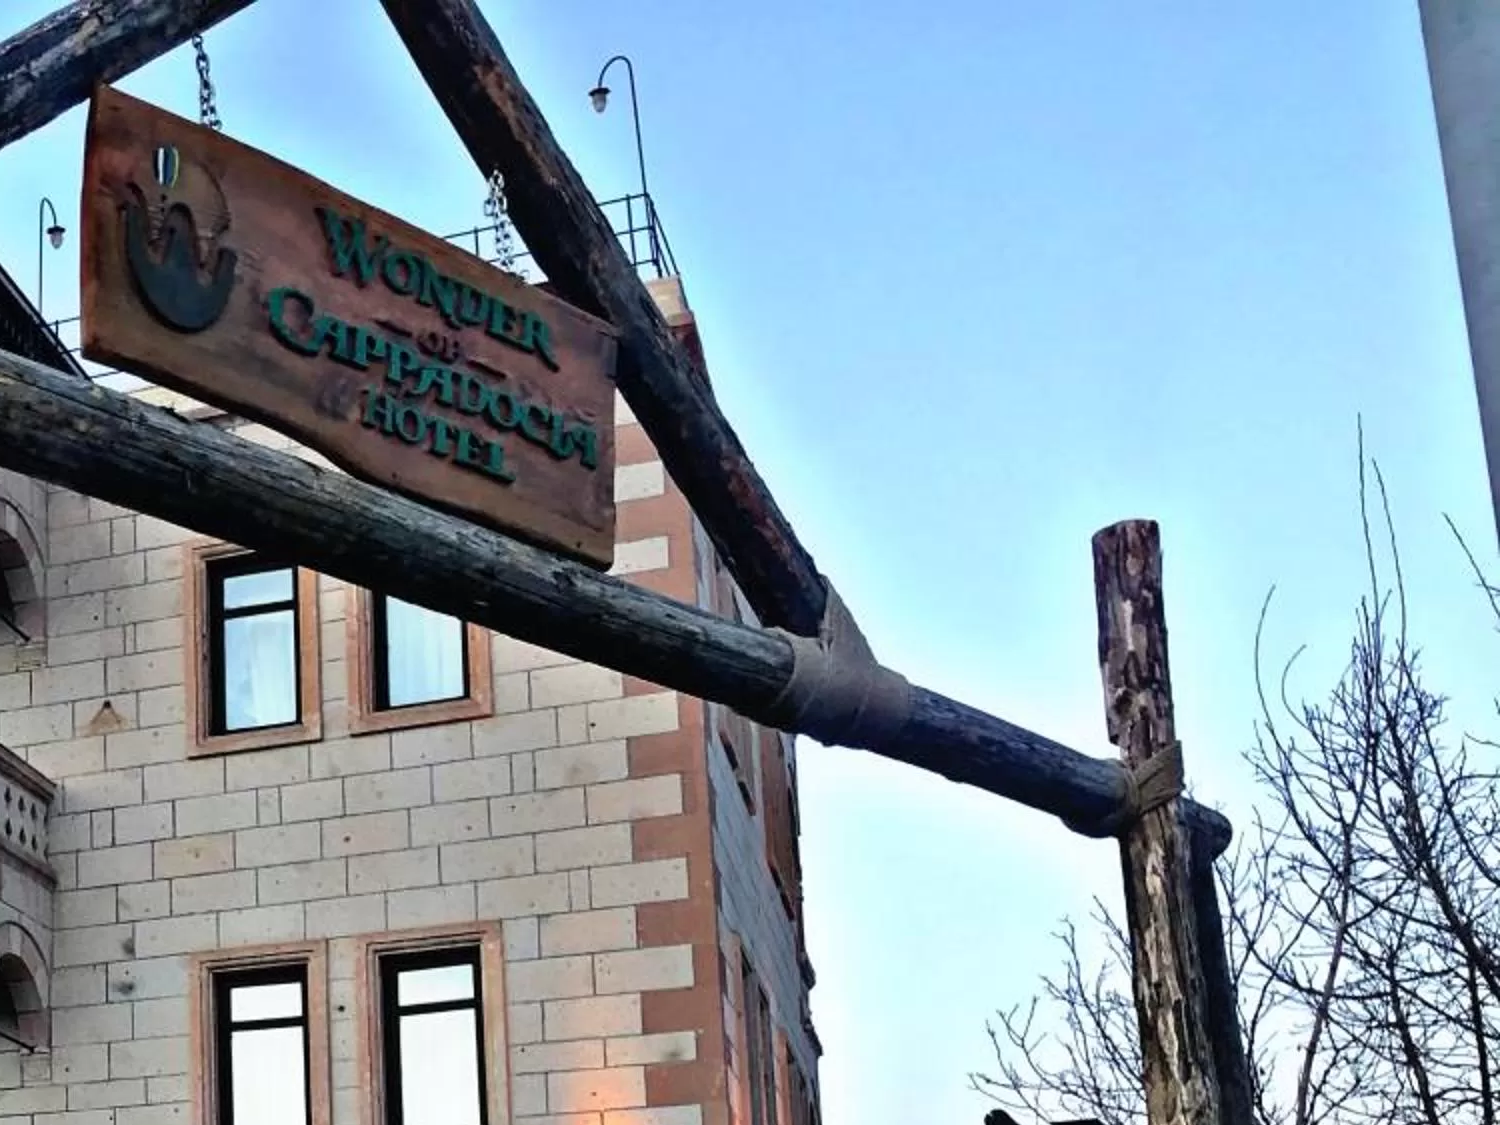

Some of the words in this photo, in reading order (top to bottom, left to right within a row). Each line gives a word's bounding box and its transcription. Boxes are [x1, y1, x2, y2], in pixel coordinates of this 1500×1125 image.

[317, 203, 560, 373] WONDER
[266, 286, 598, 470] CAPPADOCIA
[360, 383, 517, 485] HOTEL
